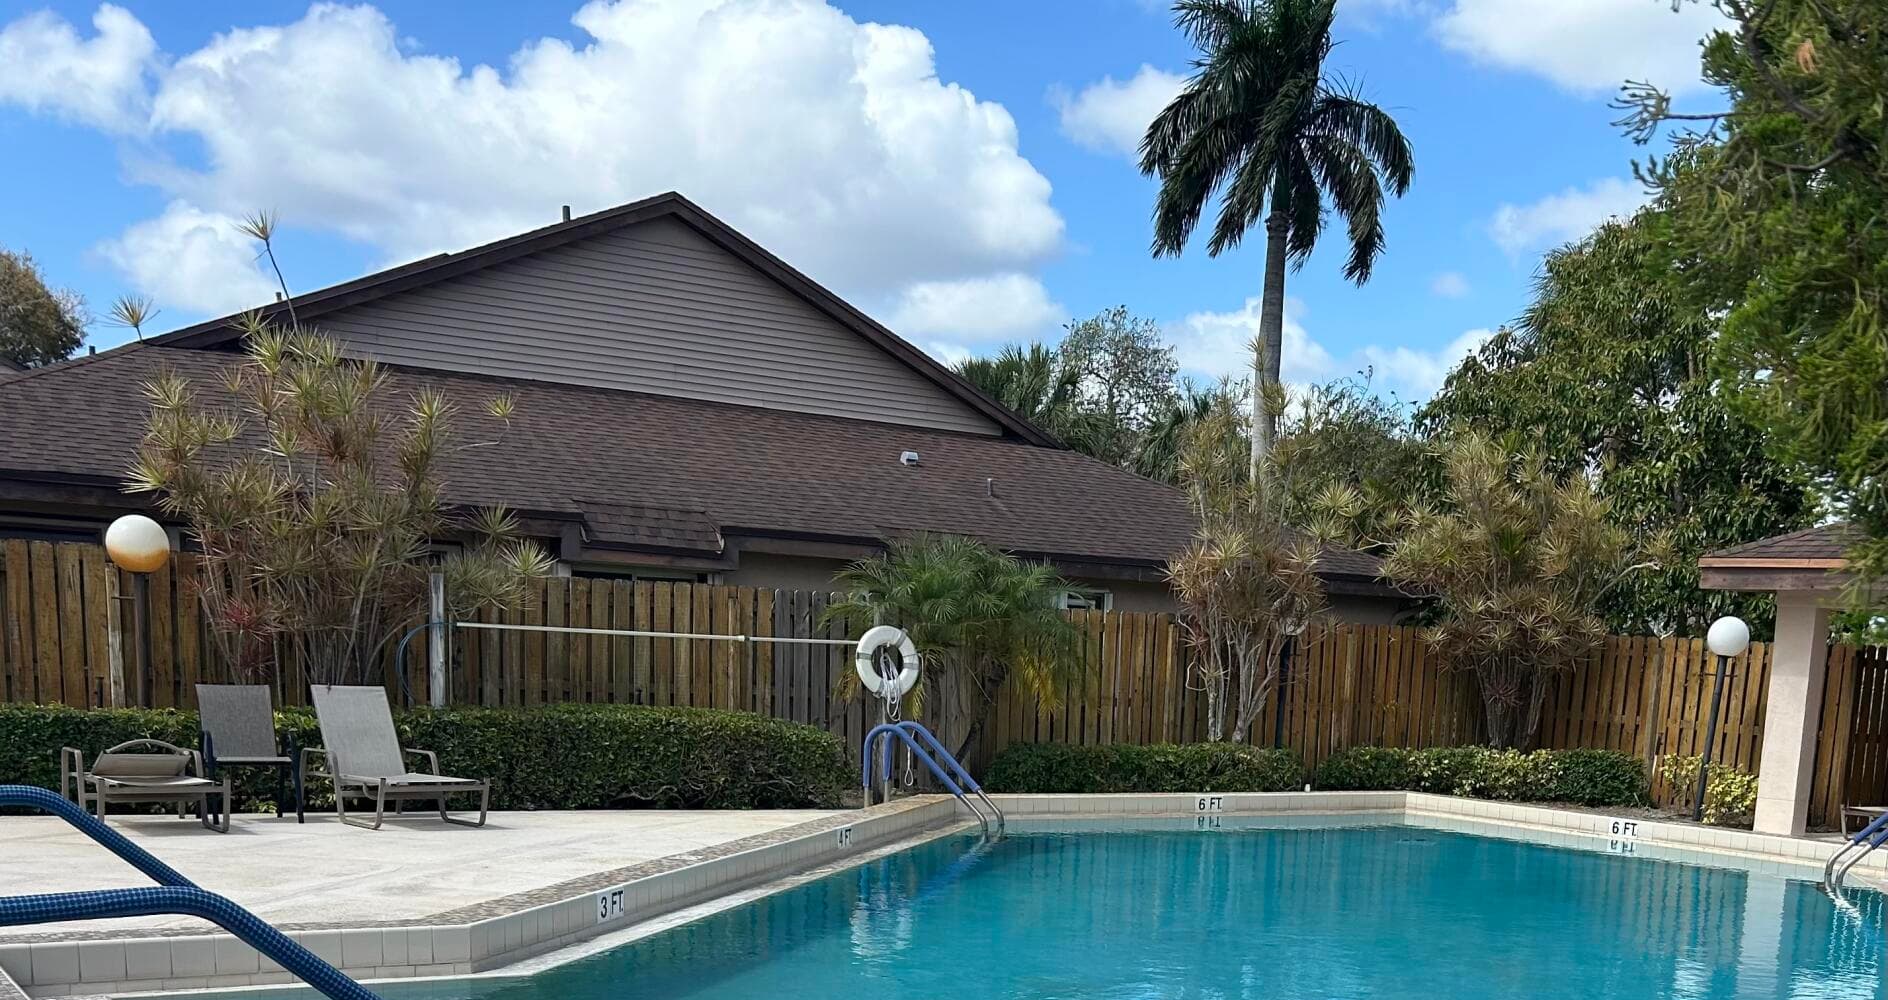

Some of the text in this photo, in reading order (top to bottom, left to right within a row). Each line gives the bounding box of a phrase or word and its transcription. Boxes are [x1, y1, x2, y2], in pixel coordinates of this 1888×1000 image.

[1198, 798, 1206, 811] 6
[1612, 821, 1620, 834] 6
[600, 890, 623, 918] 3 FT.
